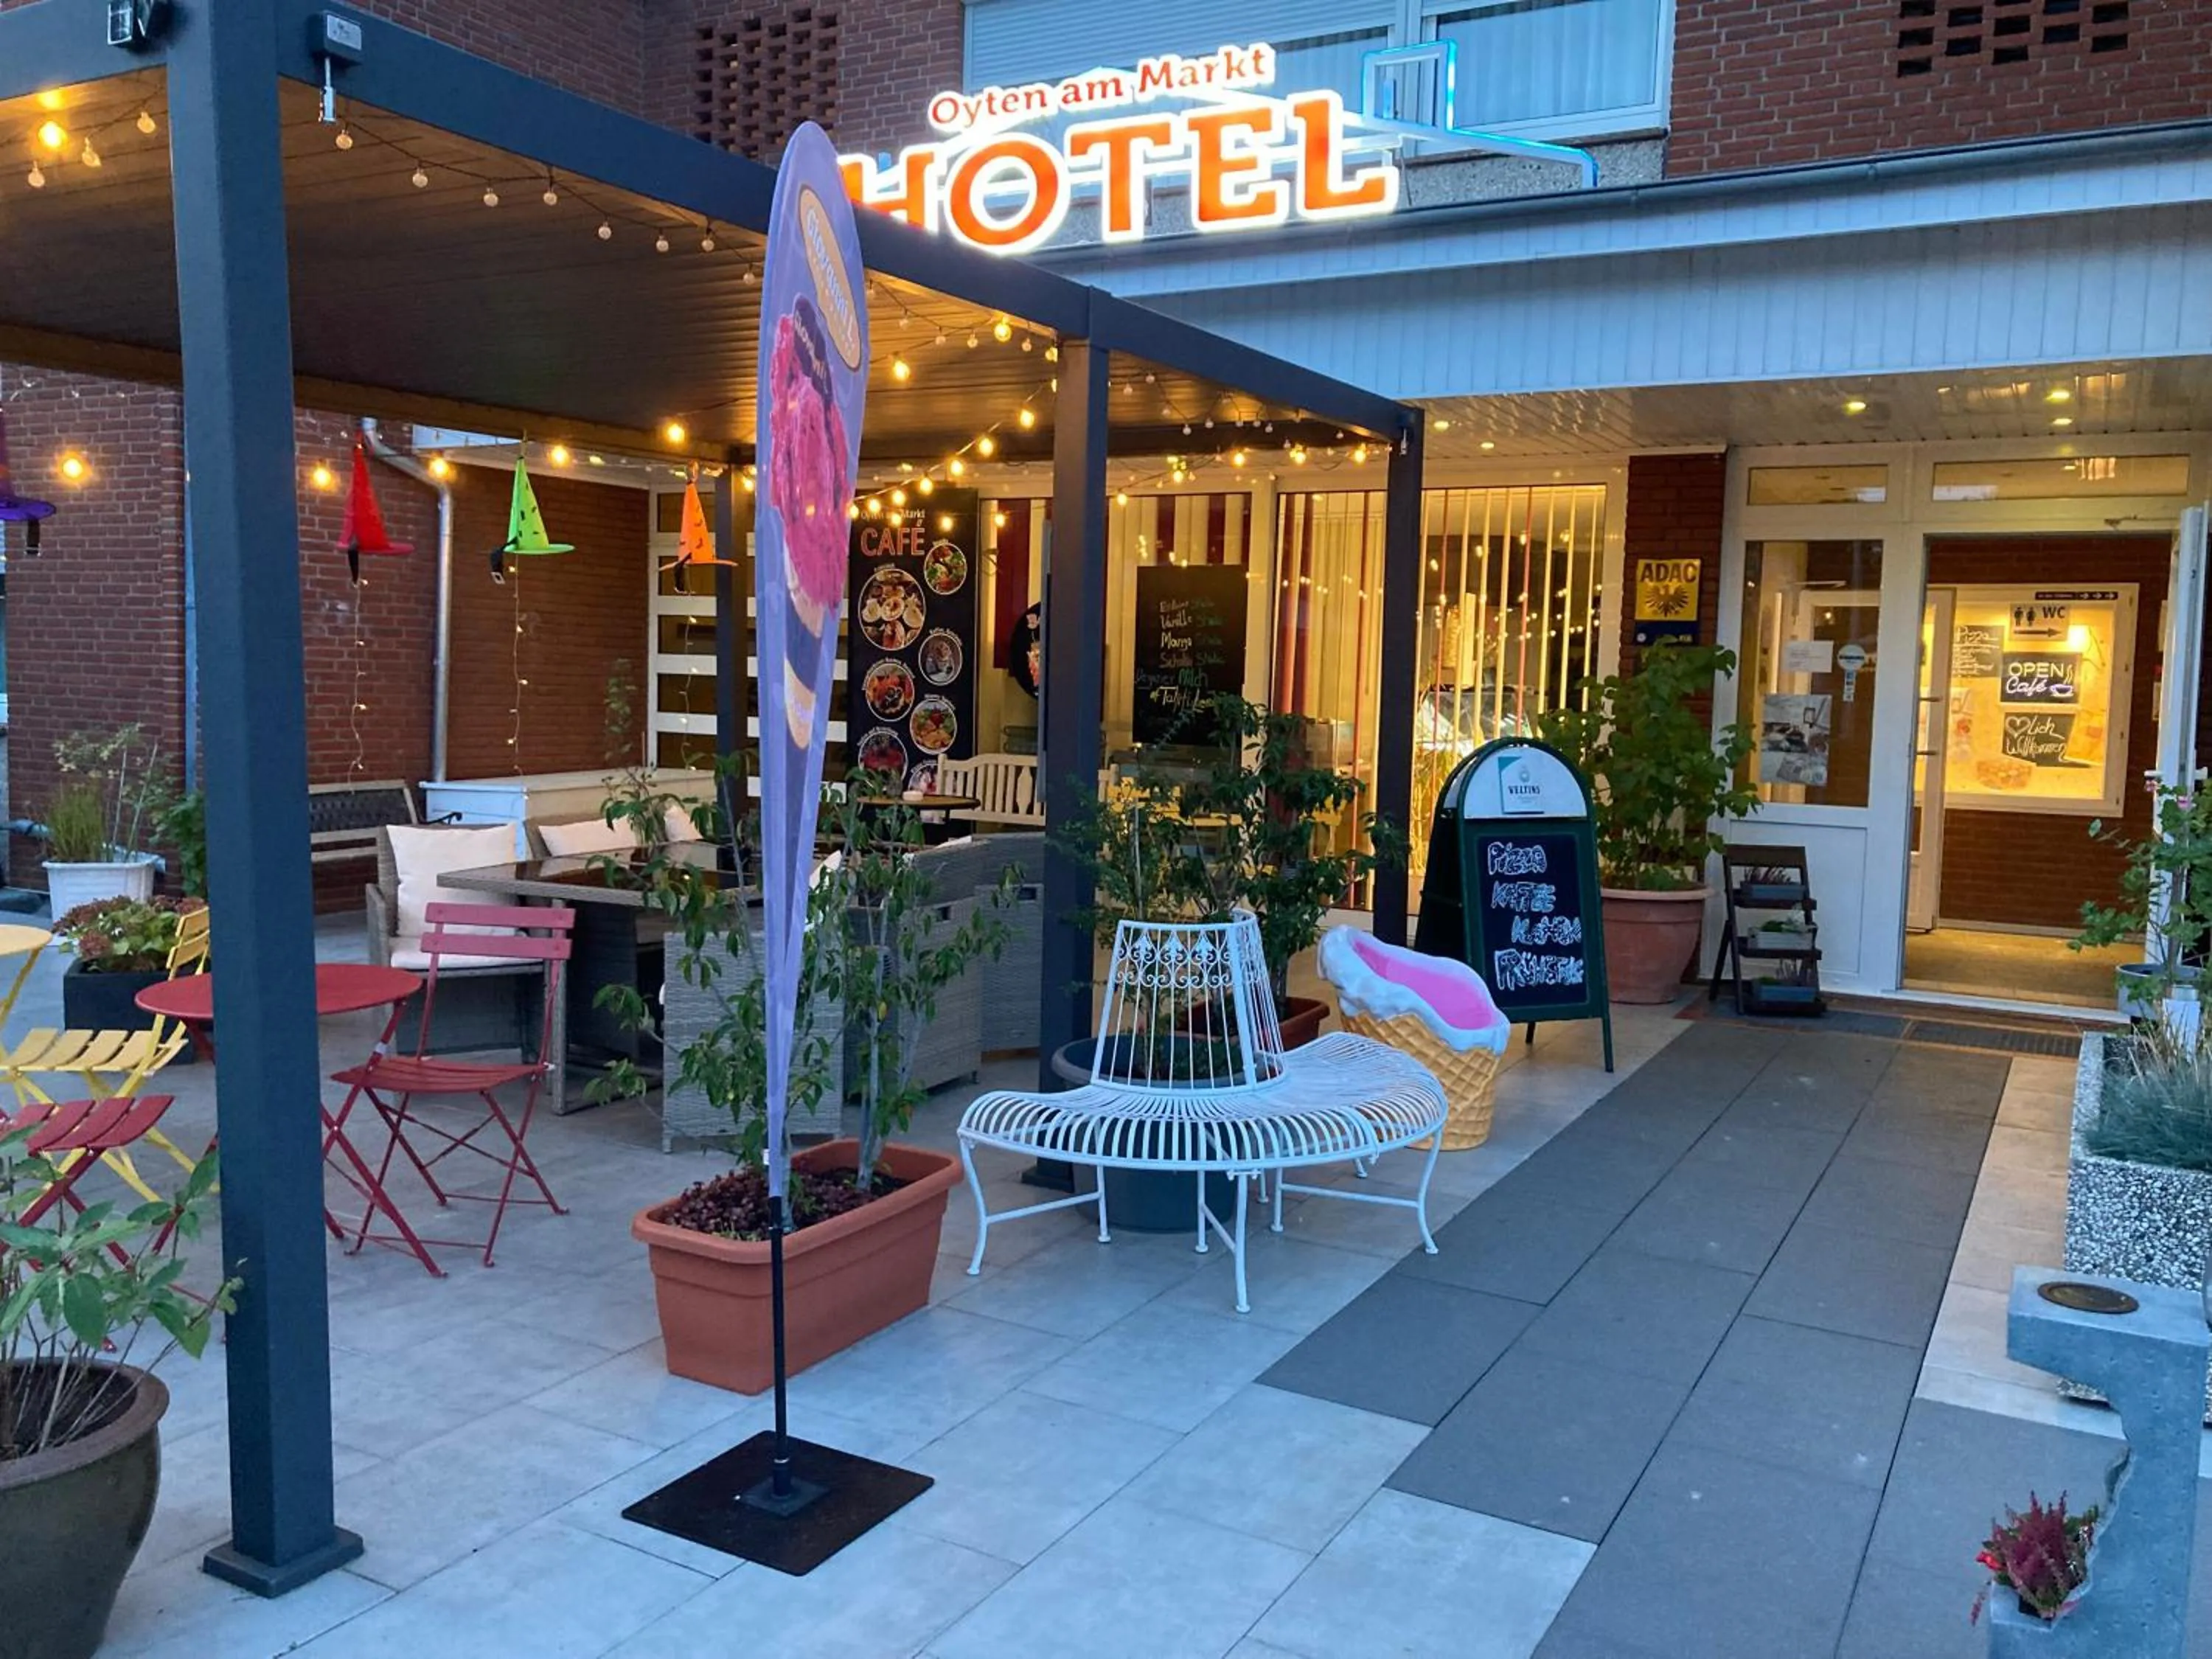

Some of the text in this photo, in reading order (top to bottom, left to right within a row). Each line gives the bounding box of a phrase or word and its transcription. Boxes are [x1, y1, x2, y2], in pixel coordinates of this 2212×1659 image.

[931, 47, 1267, 126] Oyten am Markt
[843, 97, 1388, 247] HOTEL
[860, 518, 925, 557] CAFÉ
[1640, 563, 1697, 584] ADAC
[2042, 606, 2066, 619] WC
[2008, 662, 2064, 678] OPEN
[2006, 675, 2048, 697] Café
[1507, 785, 1541, 795] VELTINS
